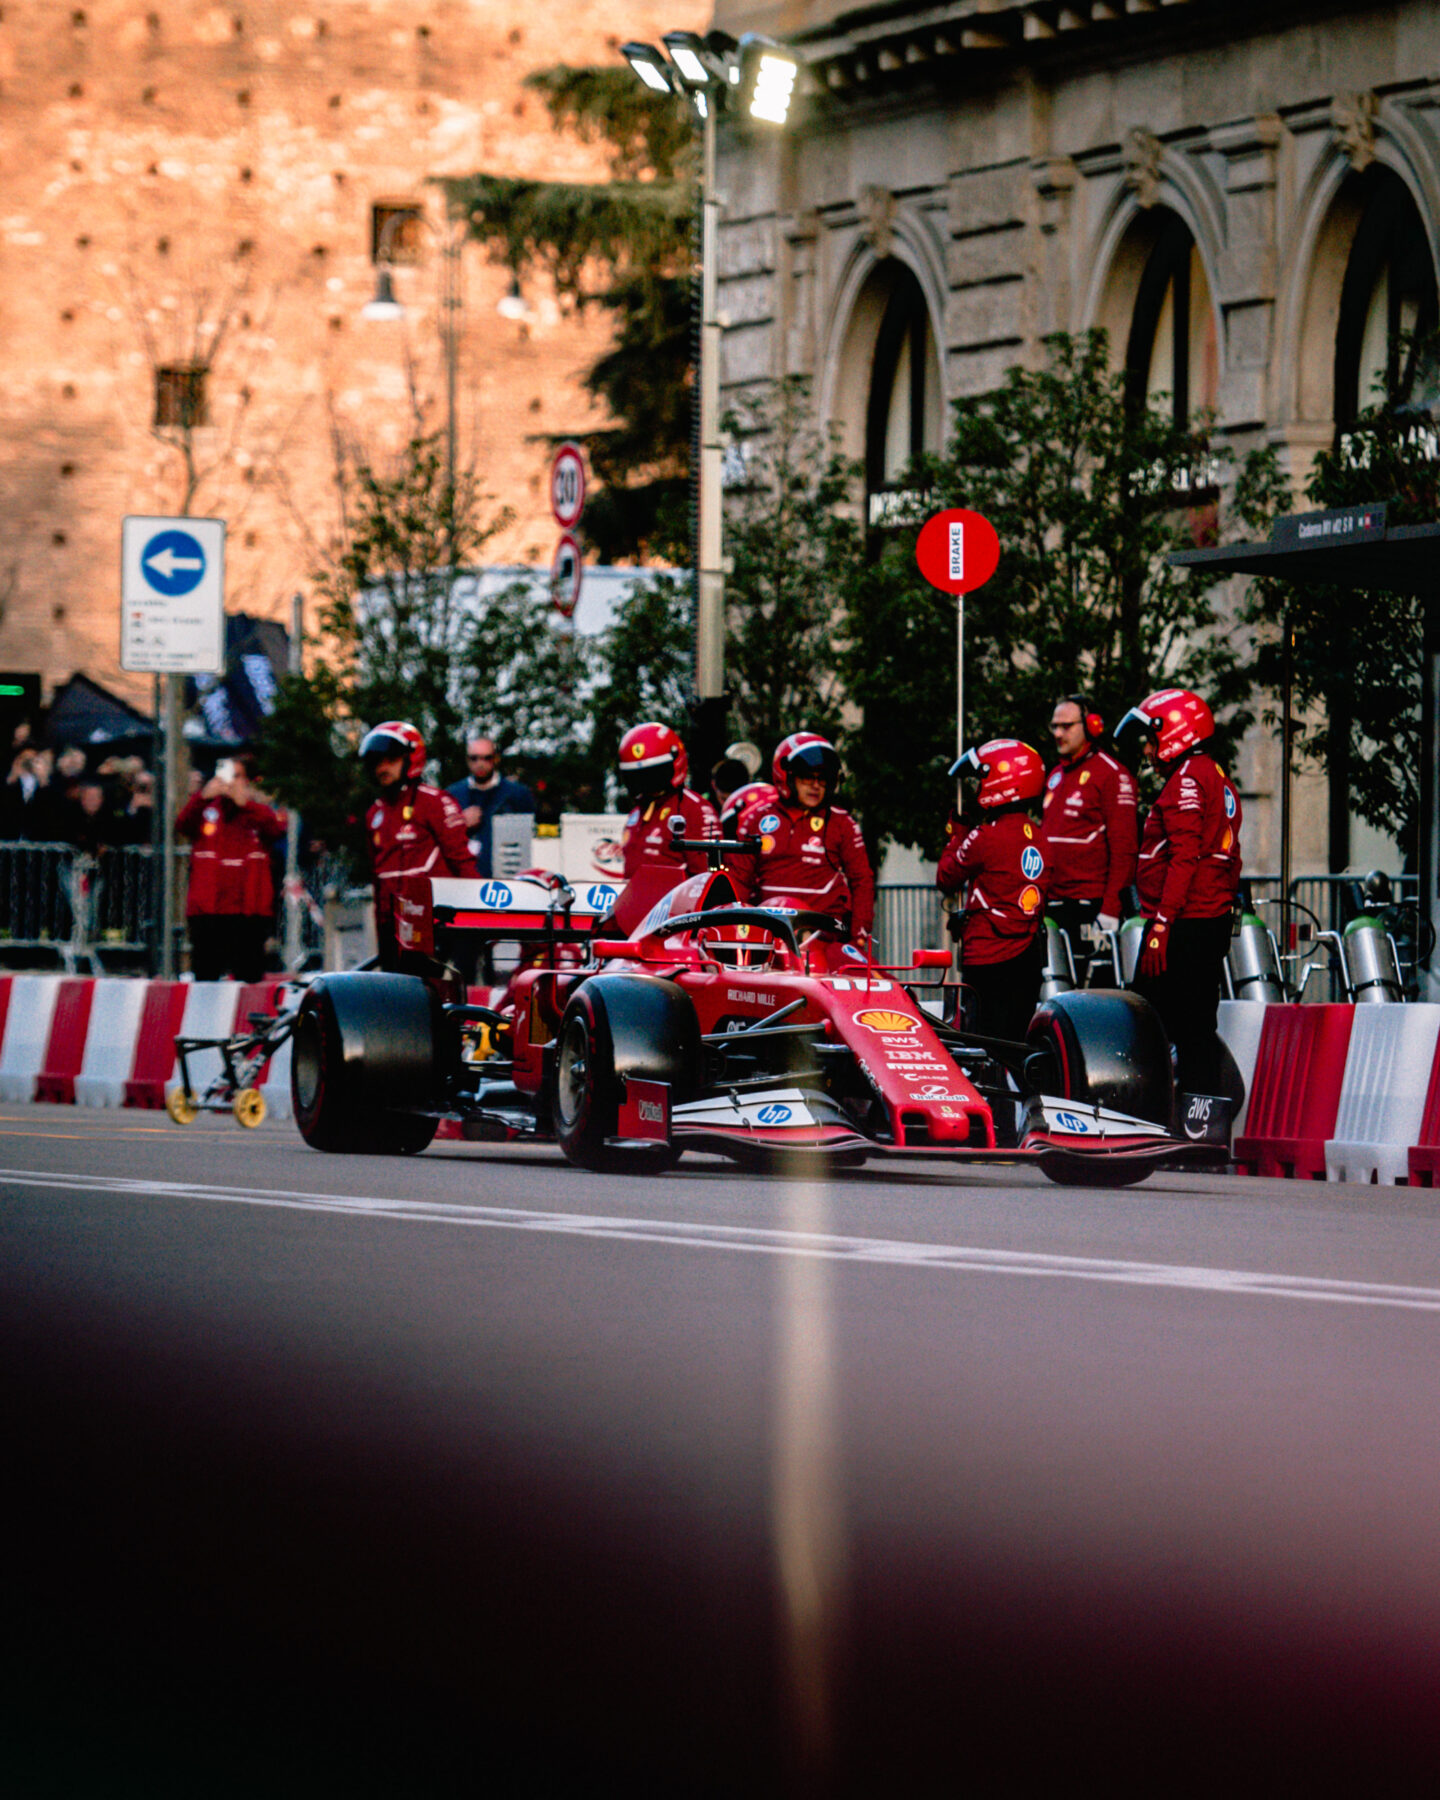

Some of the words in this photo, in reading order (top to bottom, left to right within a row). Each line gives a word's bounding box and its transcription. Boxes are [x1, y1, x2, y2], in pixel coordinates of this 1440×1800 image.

[951, 527, 961, 574] BRAKE
[1024, 847, 1041, 880] hp
[483, 882, 511, 908] hp
[590, 885, 615, 911] hp
[727, 989, 756, 1004] RICHARD
[757, 992, 776, 1006] MILLE
[881, 1036, 920, 1045] aws
[885, 1050, 937, 1061] IBM
[886, 1063, 949, 1071] PIRELLI
[909, 1093, 970, 1102] UniCredit
[760, 1105, 791, 1124] hp
[1187, 1097, 1213, 1121] aws
[1059, 1113, 1085, 1132] hp
